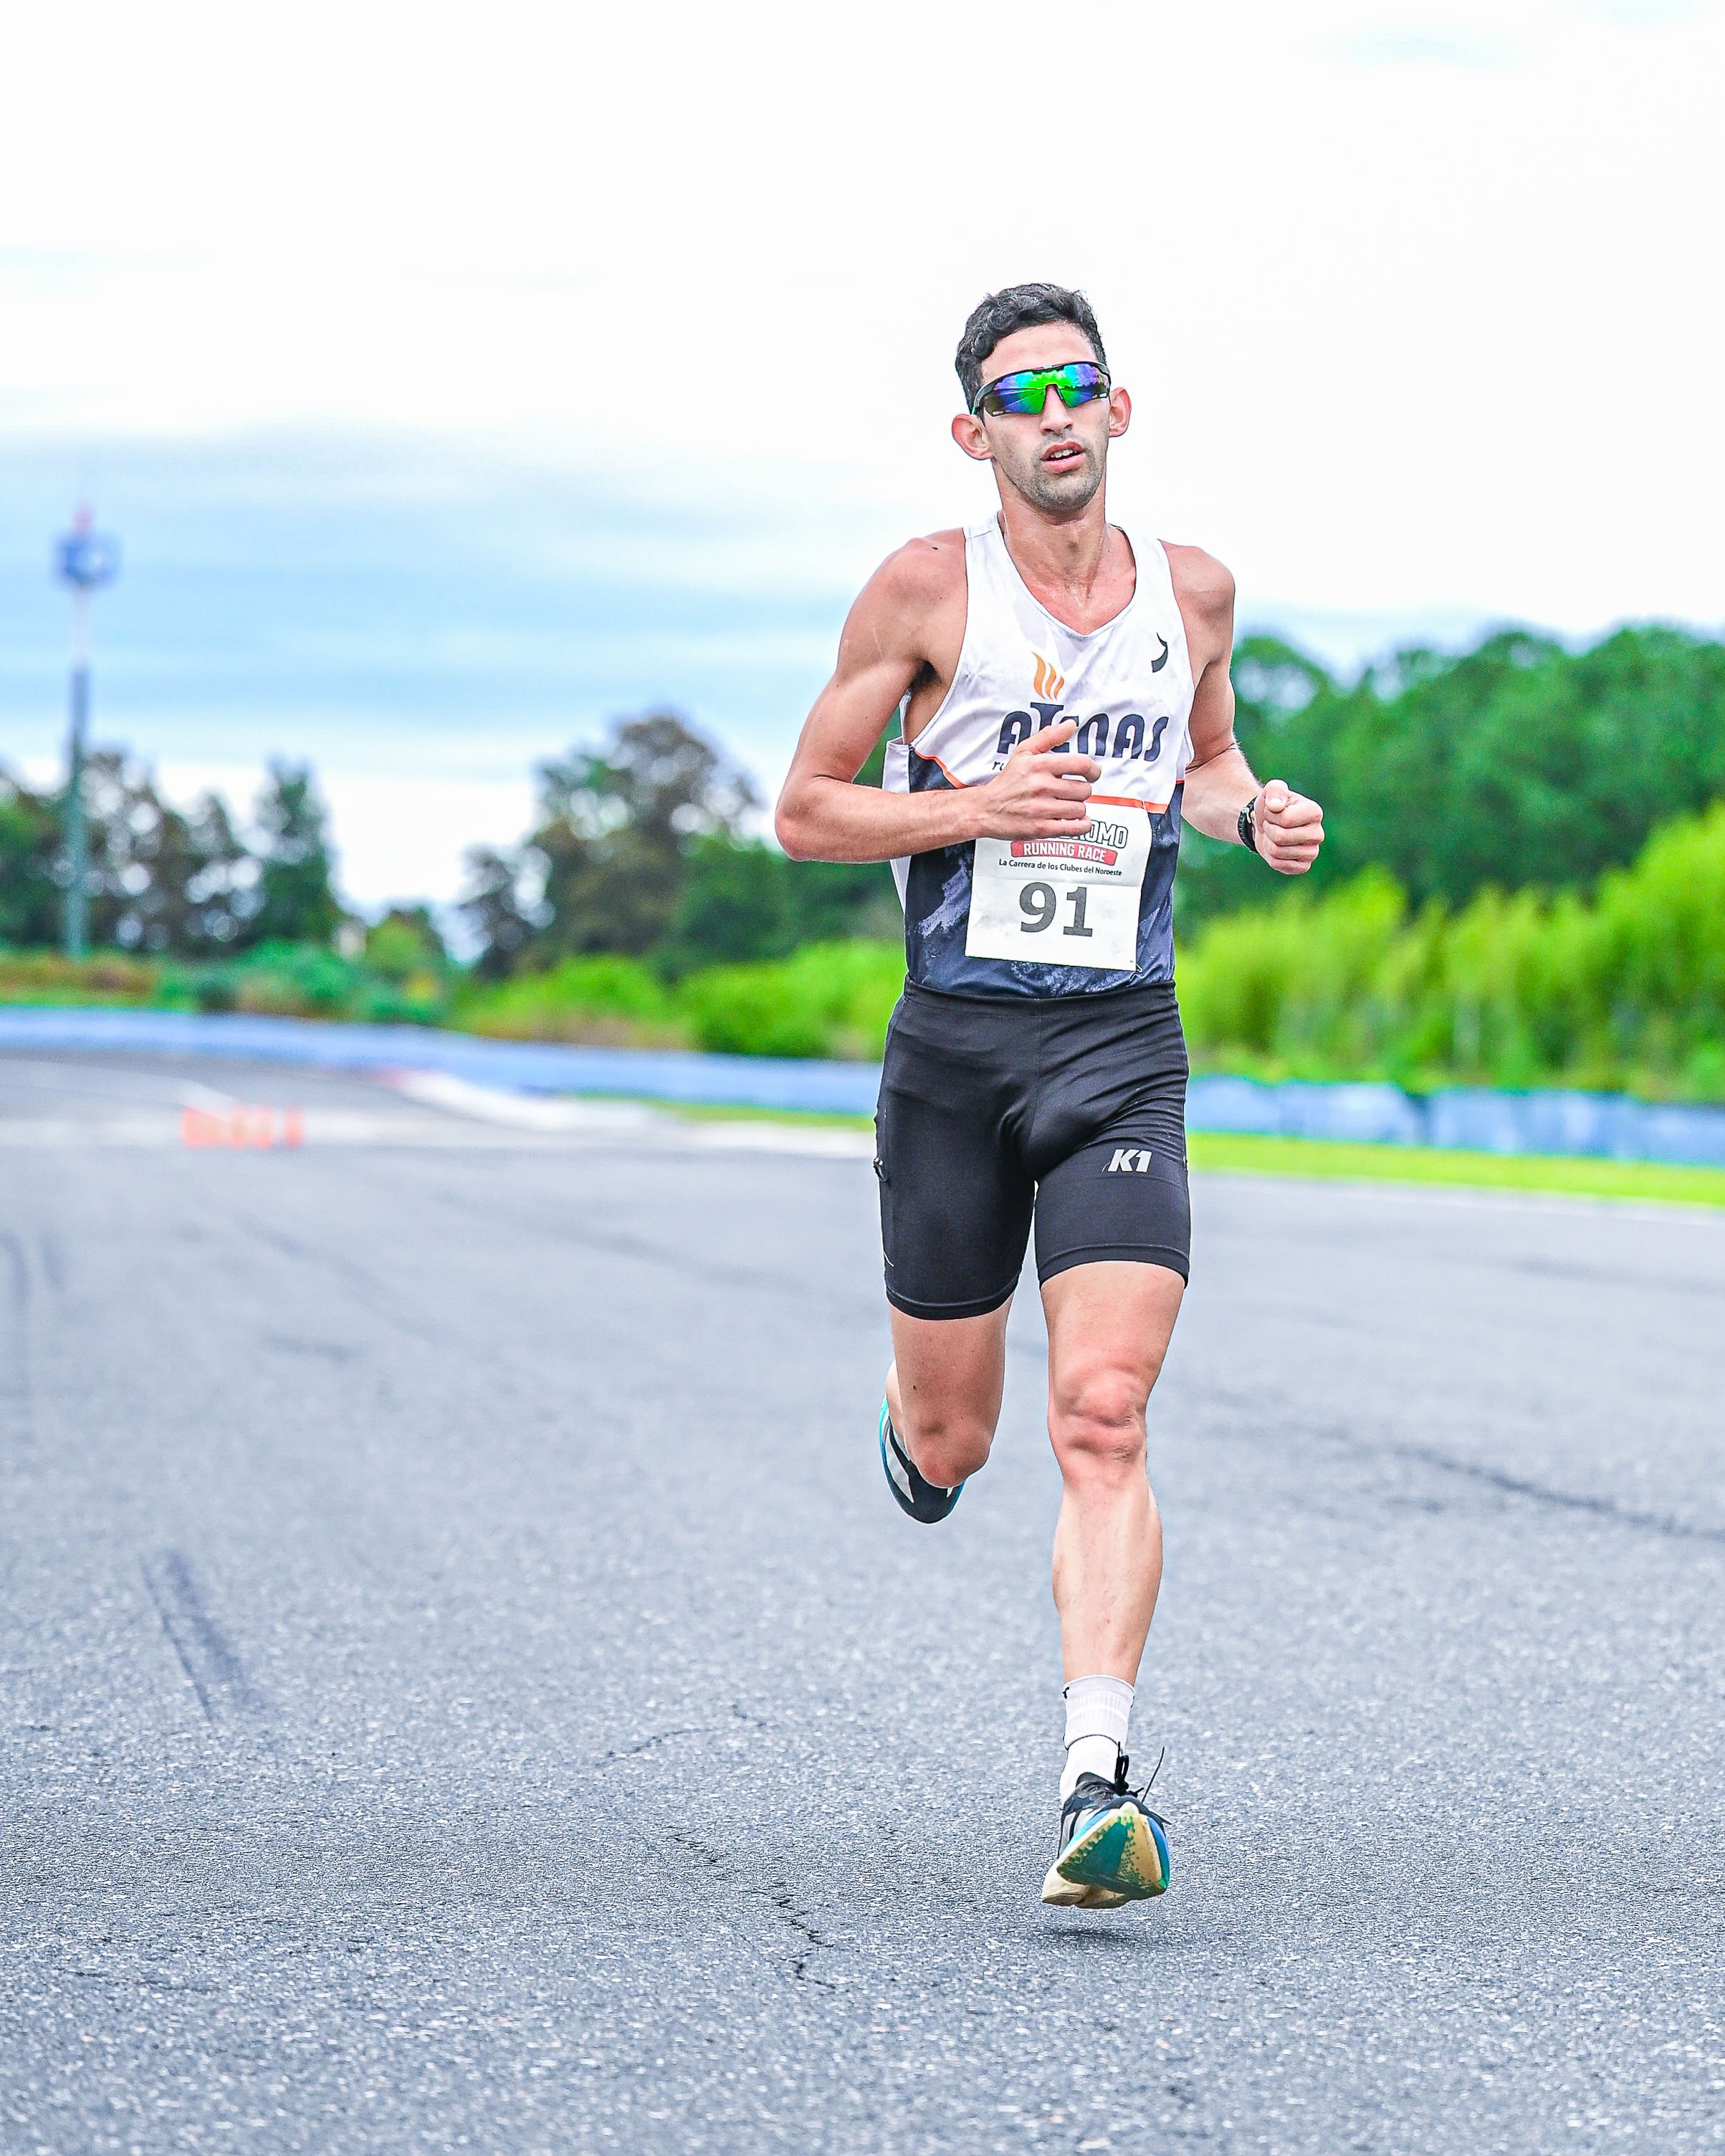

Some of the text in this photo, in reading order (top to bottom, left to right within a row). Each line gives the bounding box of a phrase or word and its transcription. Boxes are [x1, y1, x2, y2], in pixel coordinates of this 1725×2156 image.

[1023, 842, 1107, 862] RUNNING RACE
[1008, 859, 1036, 868] Carrera
[1048, 862, 1059, 871] los
[1059, 863, 1083, 873] Clubes
[1095, 867, 1122, 876] Noroeste
[1019, 881, 1093, 937] 91
[1107, 1149, 1152, 1173] K1
